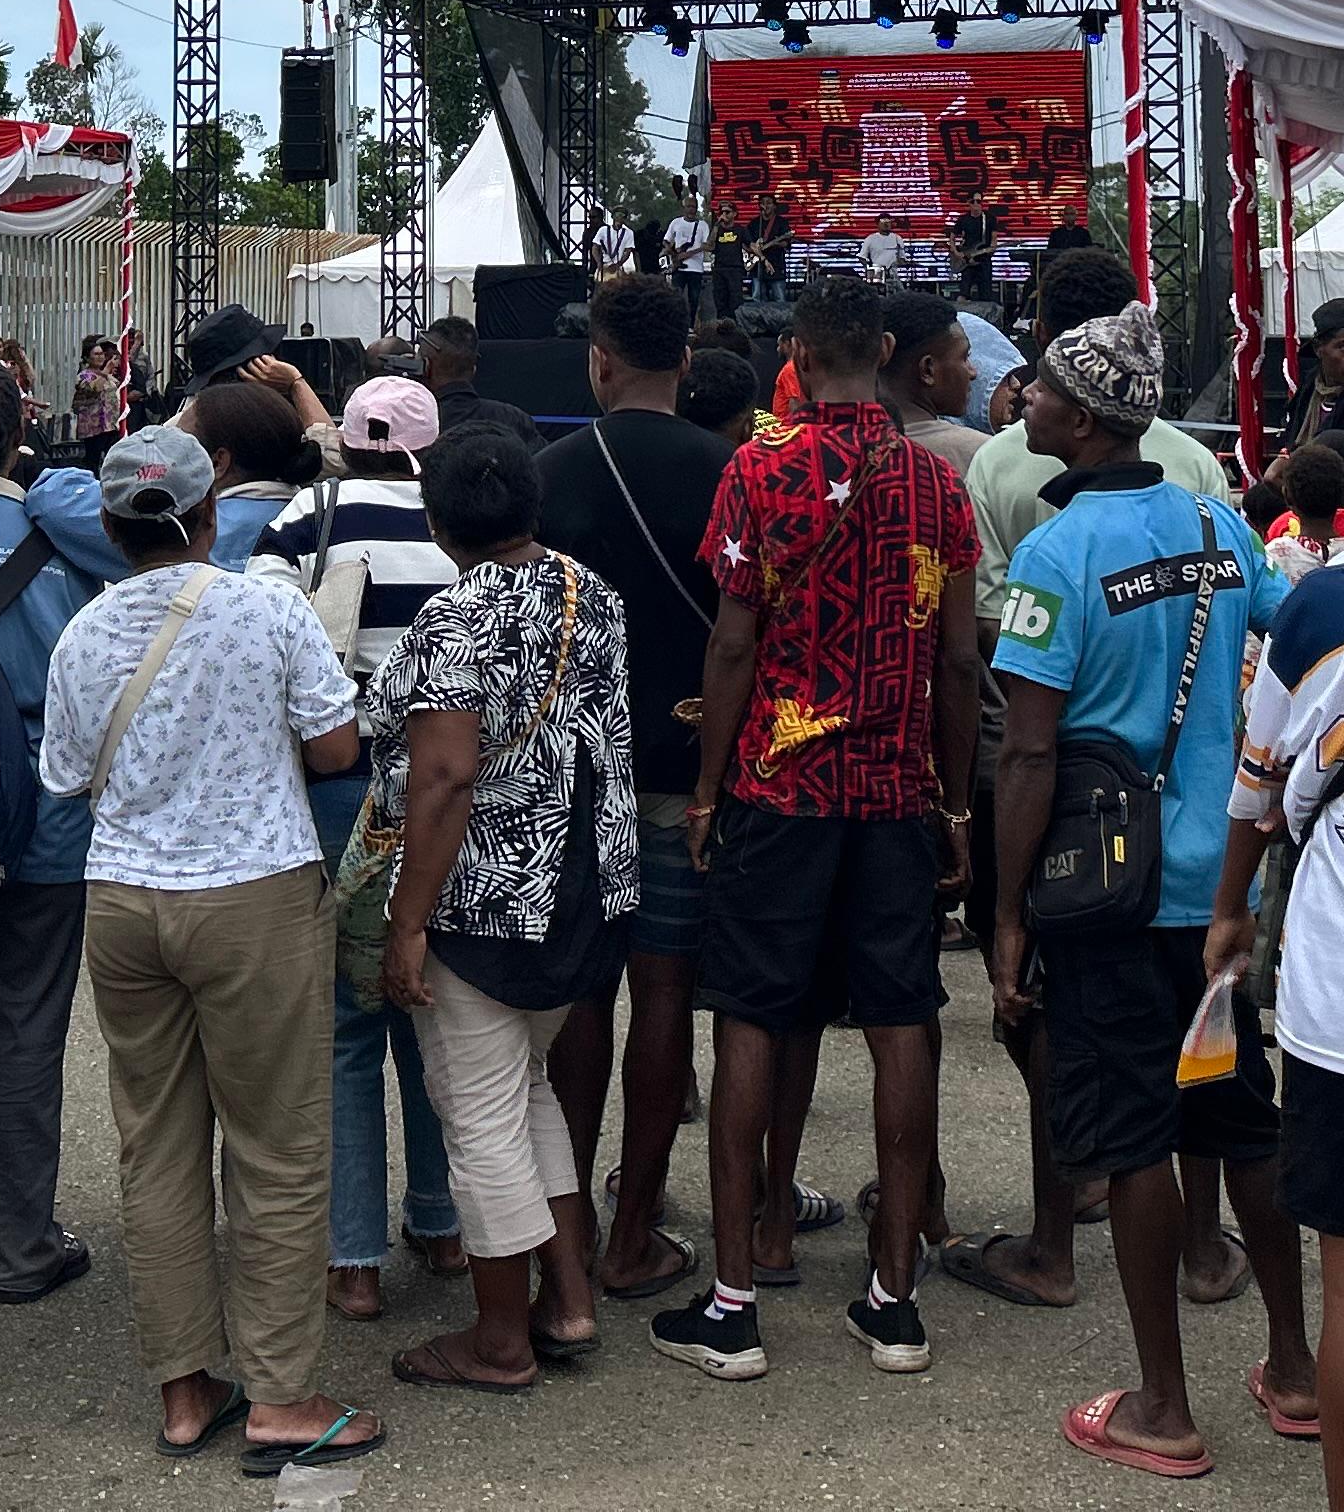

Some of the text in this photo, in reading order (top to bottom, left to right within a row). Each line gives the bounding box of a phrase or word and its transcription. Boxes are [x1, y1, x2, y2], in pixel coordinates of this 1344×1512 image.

[1058, 329, 1163, 406] YORK NE
[1108, 573, 1155, 602] THE
[1171, 562, 1216, 725] CATERPILLAR
[1044, 849, 1081, 880] CAT
